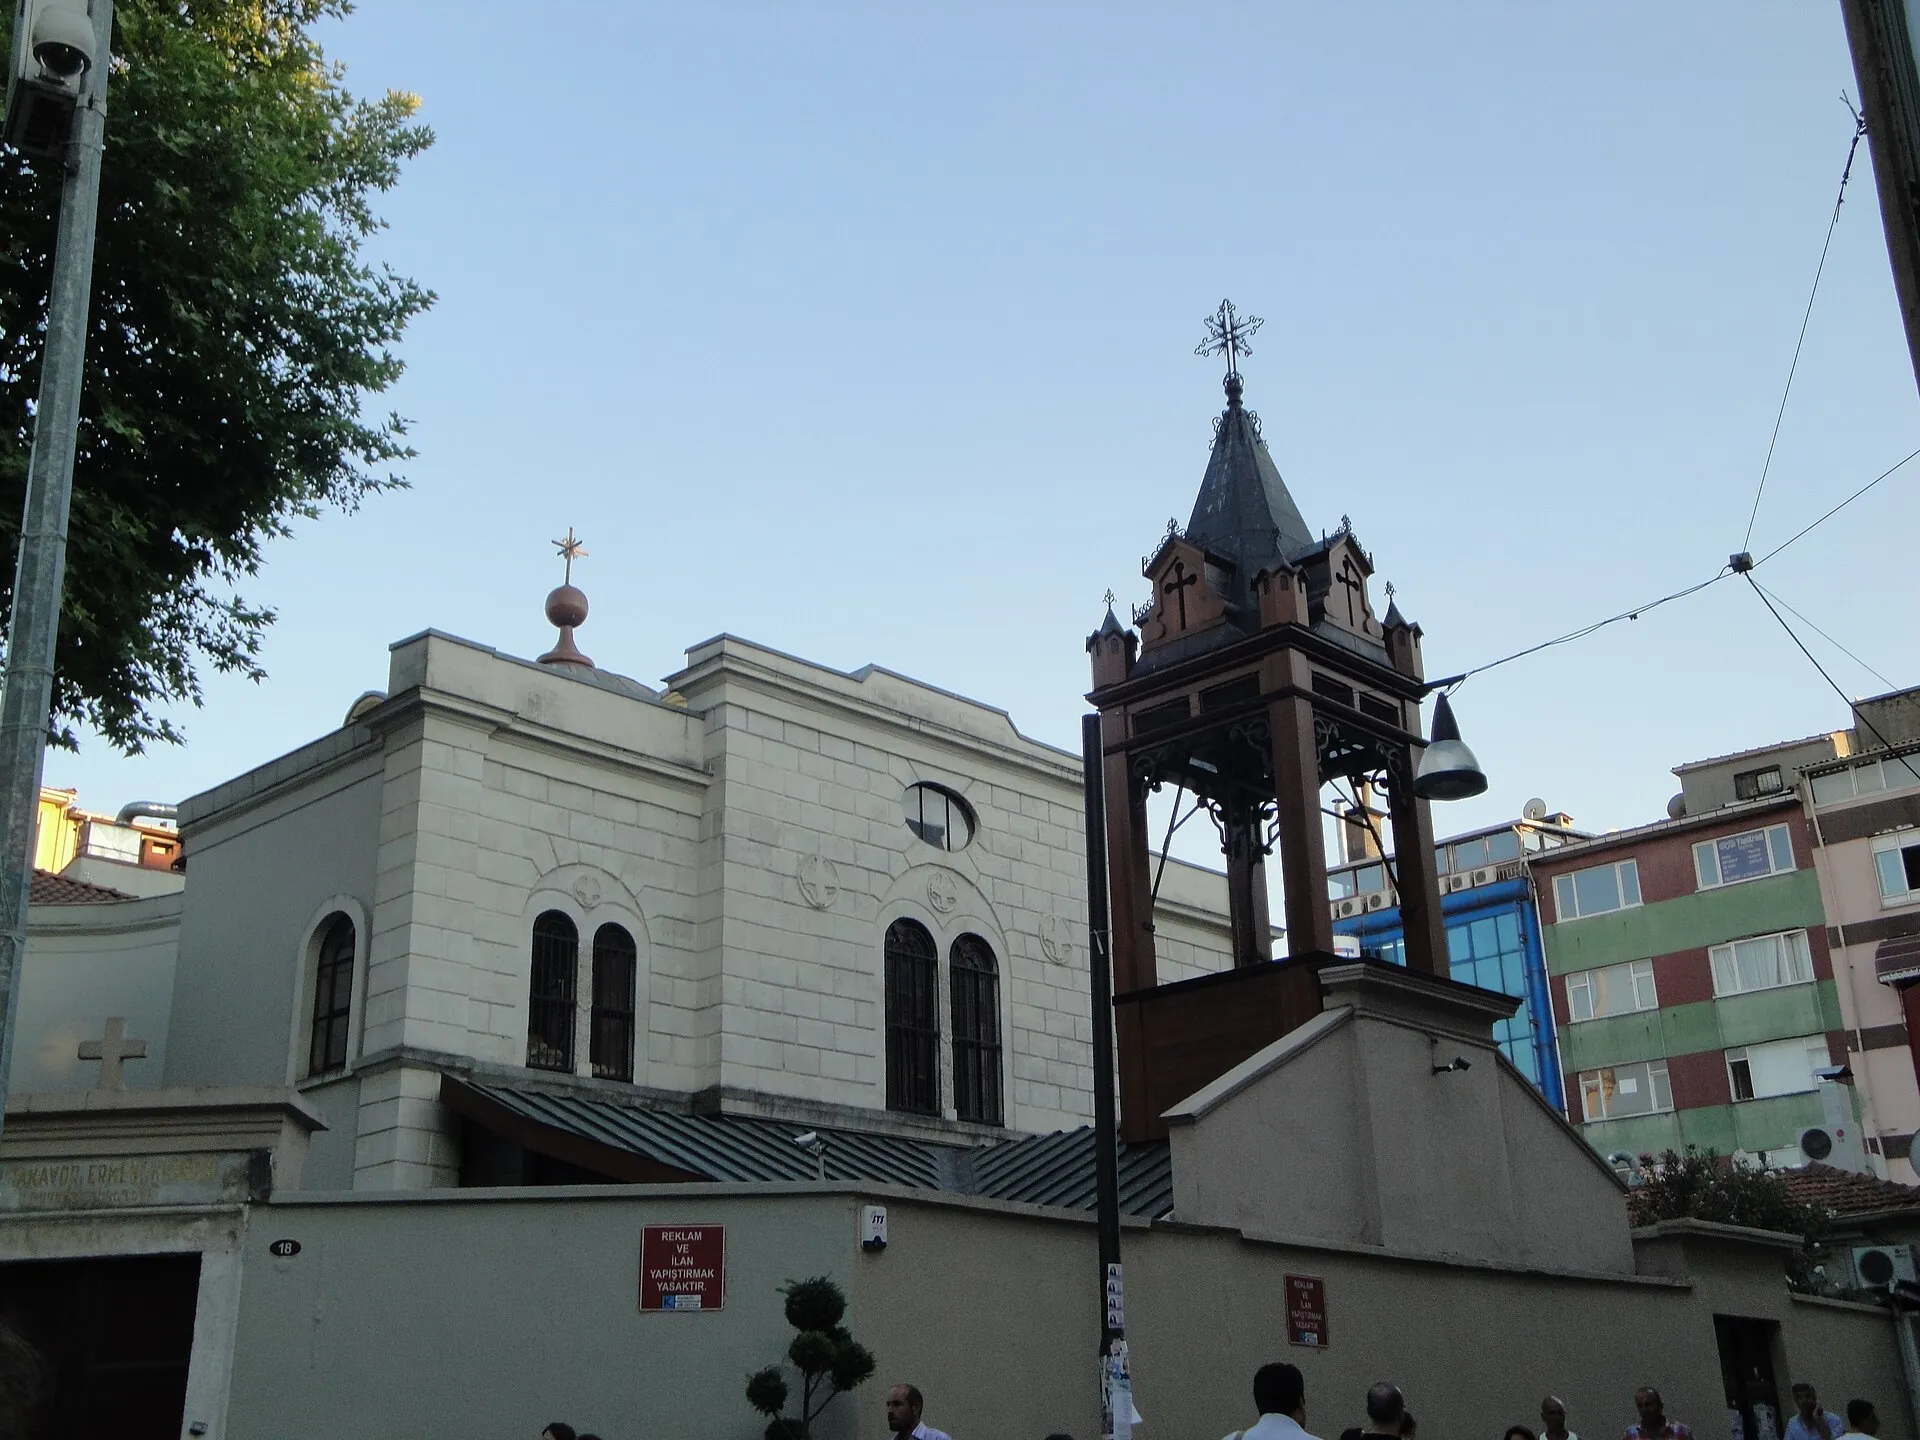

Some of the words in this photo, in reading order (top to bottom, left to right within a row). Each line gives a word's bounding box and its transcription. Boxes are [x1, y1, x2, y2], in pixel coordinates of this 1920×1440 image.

[661, 1231, 702, 1241] REKLAM
[278, 1242, 292, 1254] 18
[676, 1243, 690, 1254] VE
[671, 1254, 694, 1266] İLAN
[650, 1268, 714, 1281] YAPIŞTIRMAK
[656, 1281, 707, 1292] YASAKTIR.
